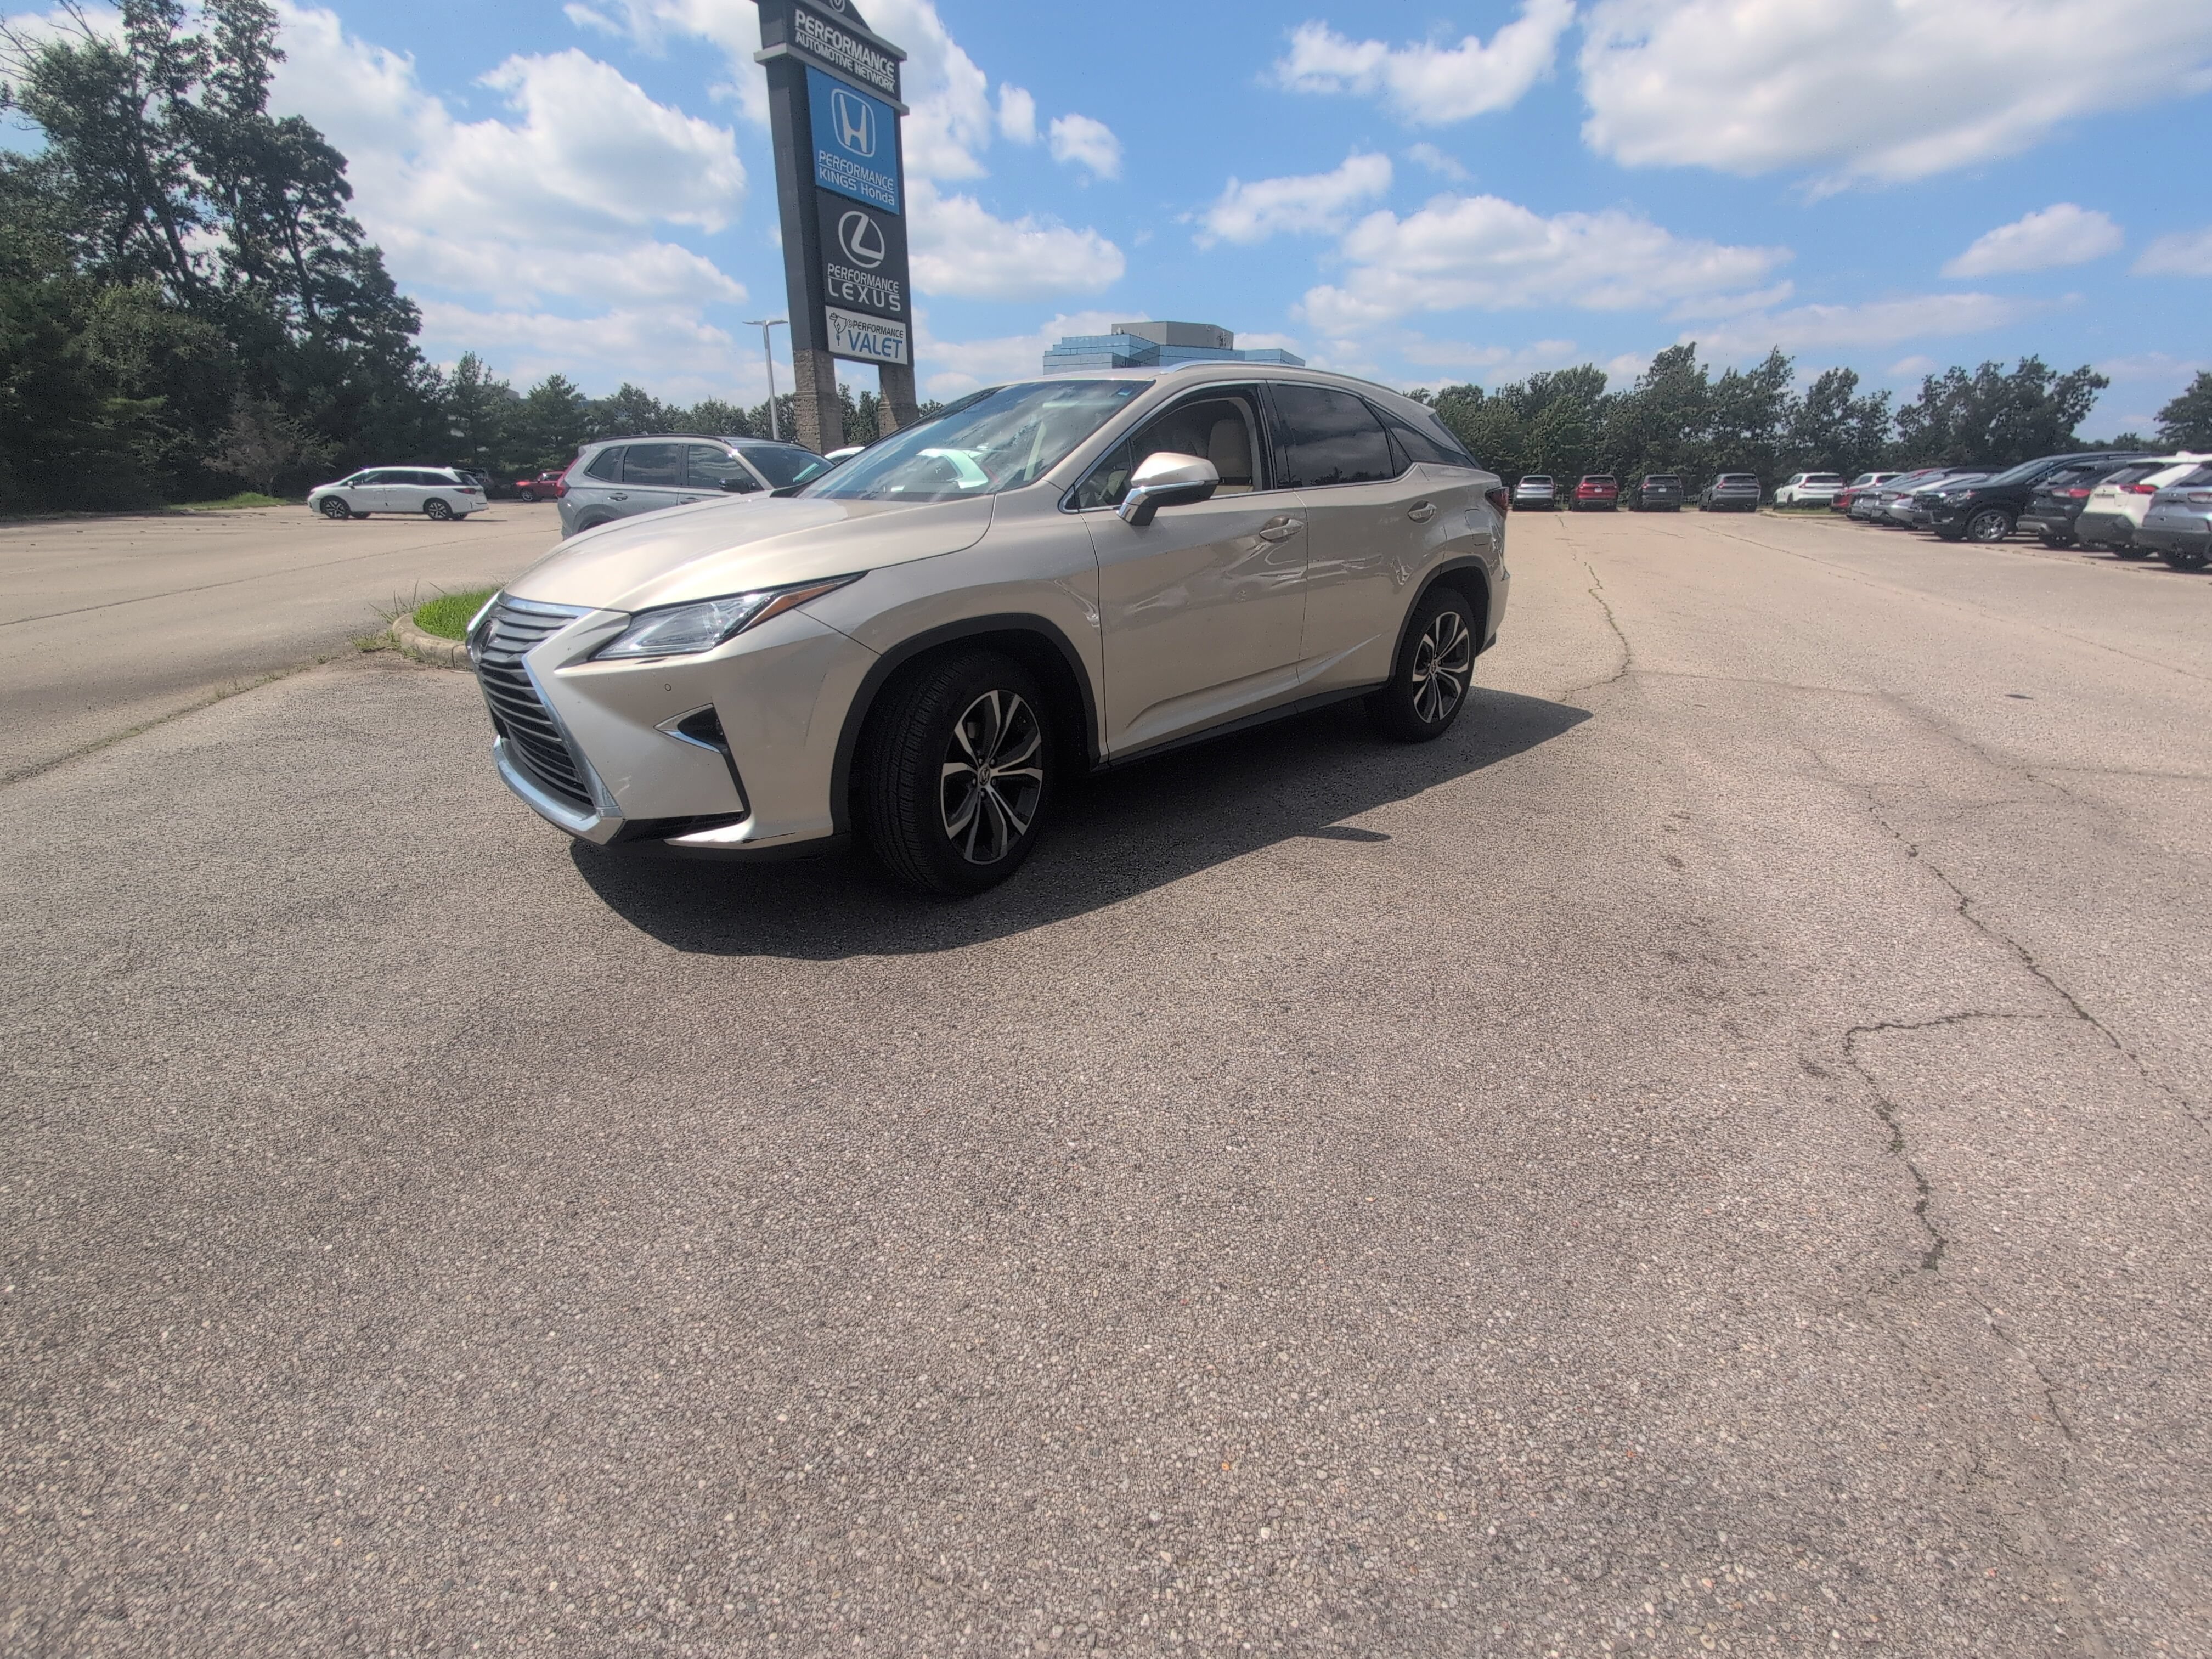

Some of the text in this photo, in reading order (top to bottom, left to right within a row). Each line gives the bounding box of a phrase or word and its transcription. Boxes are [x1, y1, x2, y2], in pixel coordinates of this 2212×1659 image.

[795, 9, 895, 78] PERFORMANCE
[795, 32, 895, 94] AUTOMOTIVE NETWORK
[819, 150, 894, 191] PERFORMANCE
[819, 167, 857, 191] KINGS
[828, 263, 900, 293] PERFORMANCE
[828, 278, 901, 312] LEXUS
[848, 329, 902, 358] VALET
[853, 320, 904, 338] PERFORMANCE
